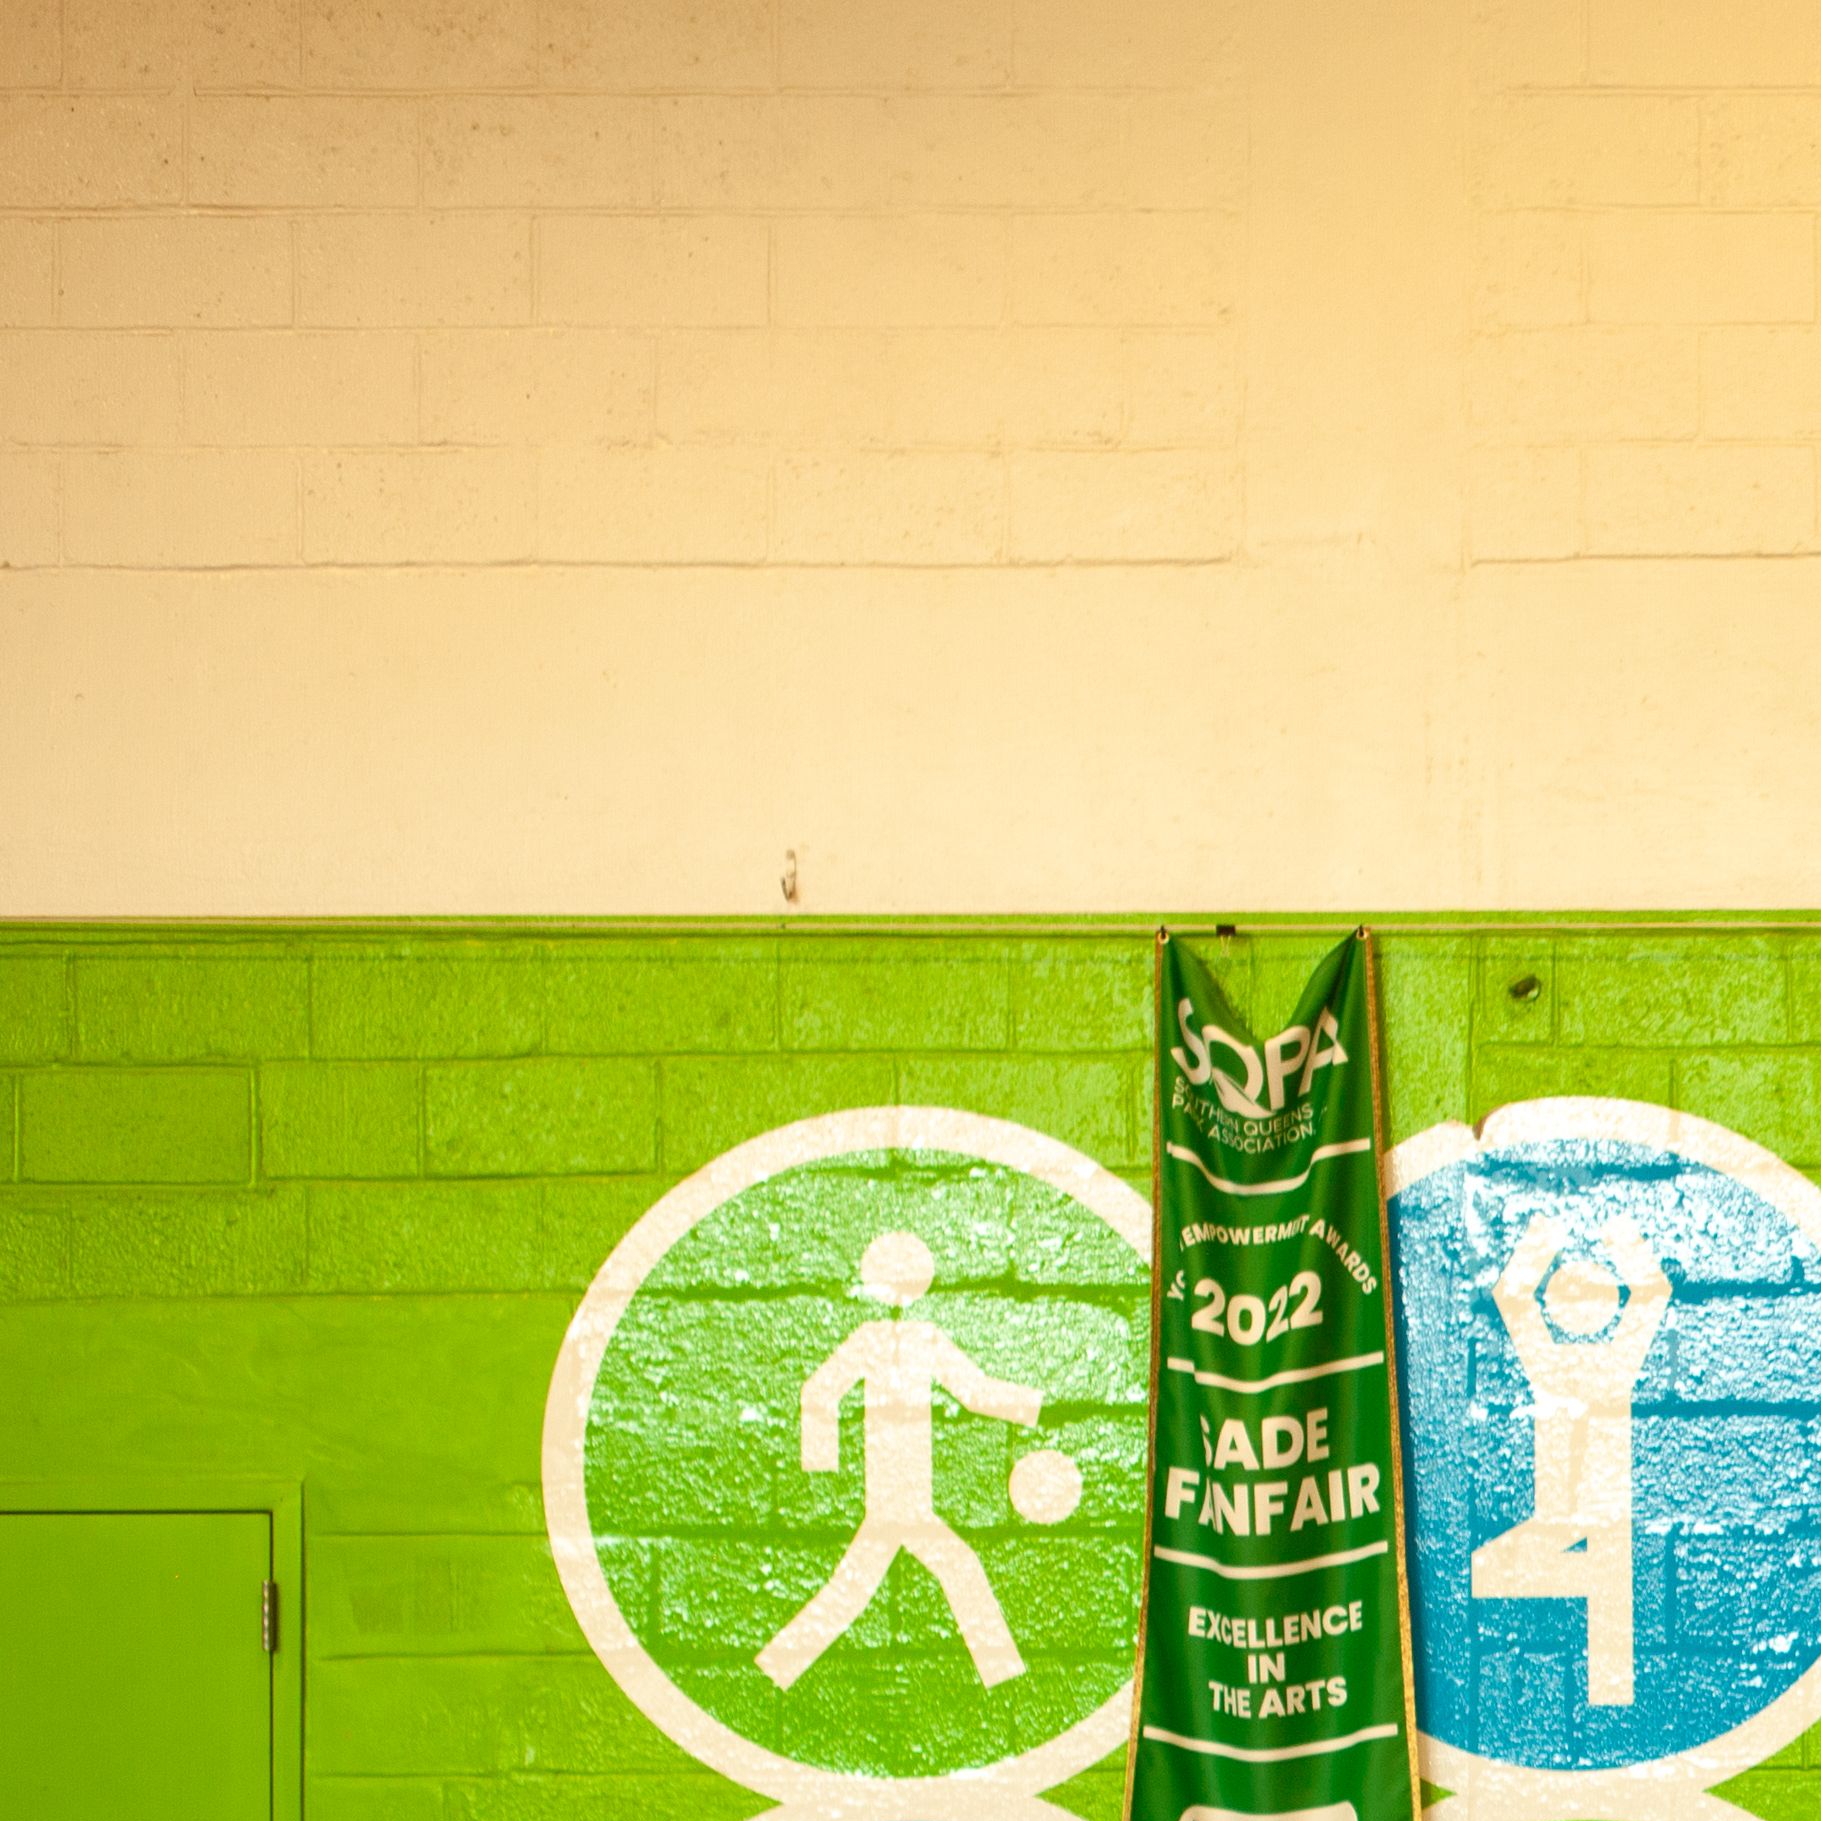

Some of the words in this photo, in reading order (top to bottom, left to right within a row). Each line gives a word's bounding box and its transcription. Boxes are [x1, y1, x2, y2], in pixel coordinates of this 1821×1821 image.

[1310, 1219, 1378, 1295] AWARDS
[1191, 1270, 1324, 1347] 2022
[1188, 1600, 1363, 1649] EXCELLENCE
[1247, 1652, 1286, 1685] IN
[1208, 1680, 1252, 1719] THE
[1257, 1676, 1349, 1719] ARTS
